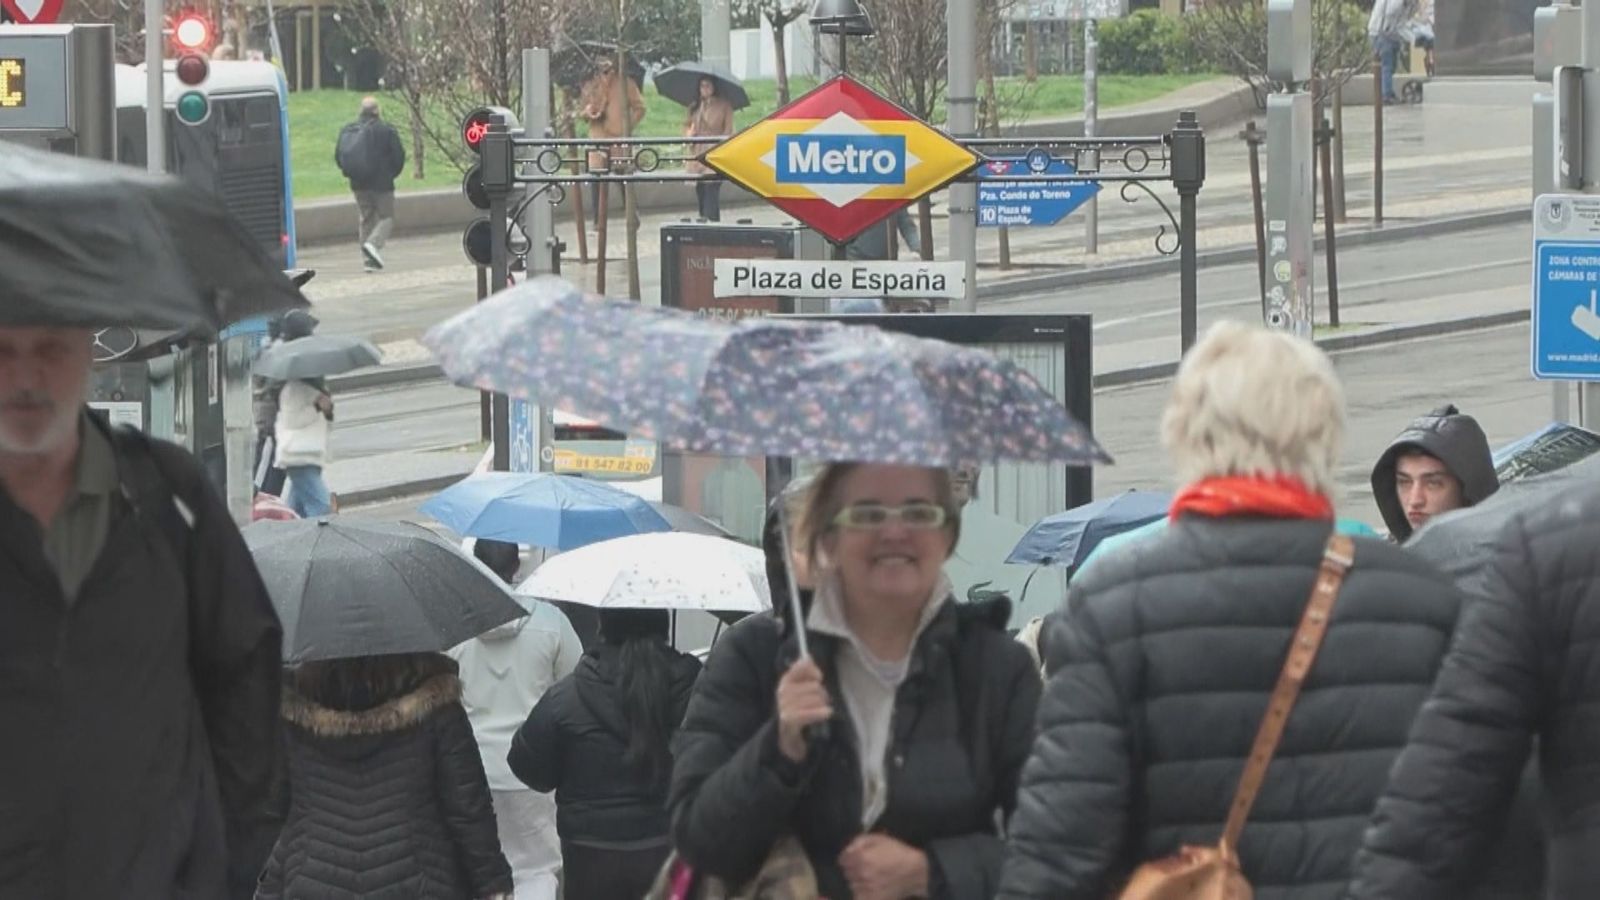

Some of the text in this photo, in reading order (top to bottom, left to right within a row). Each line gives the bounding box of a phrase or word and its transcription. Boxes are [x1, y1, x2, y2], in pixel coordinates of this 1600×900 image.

[788, 141, 897, 174] Metro
[999, 190, 1027, 200] Conde
[1028, 190, 1040, 200] de
[1041, 189, 1071, 200] Toreno
[981, 208, 996, 222] 10
[998, 205, 1032, 215] Plaza de
[1548, 255, 1570, 266] ZONA
[733, 266, 946, 295] Plaza de España
[1586, 271, 1598, 281] DE
